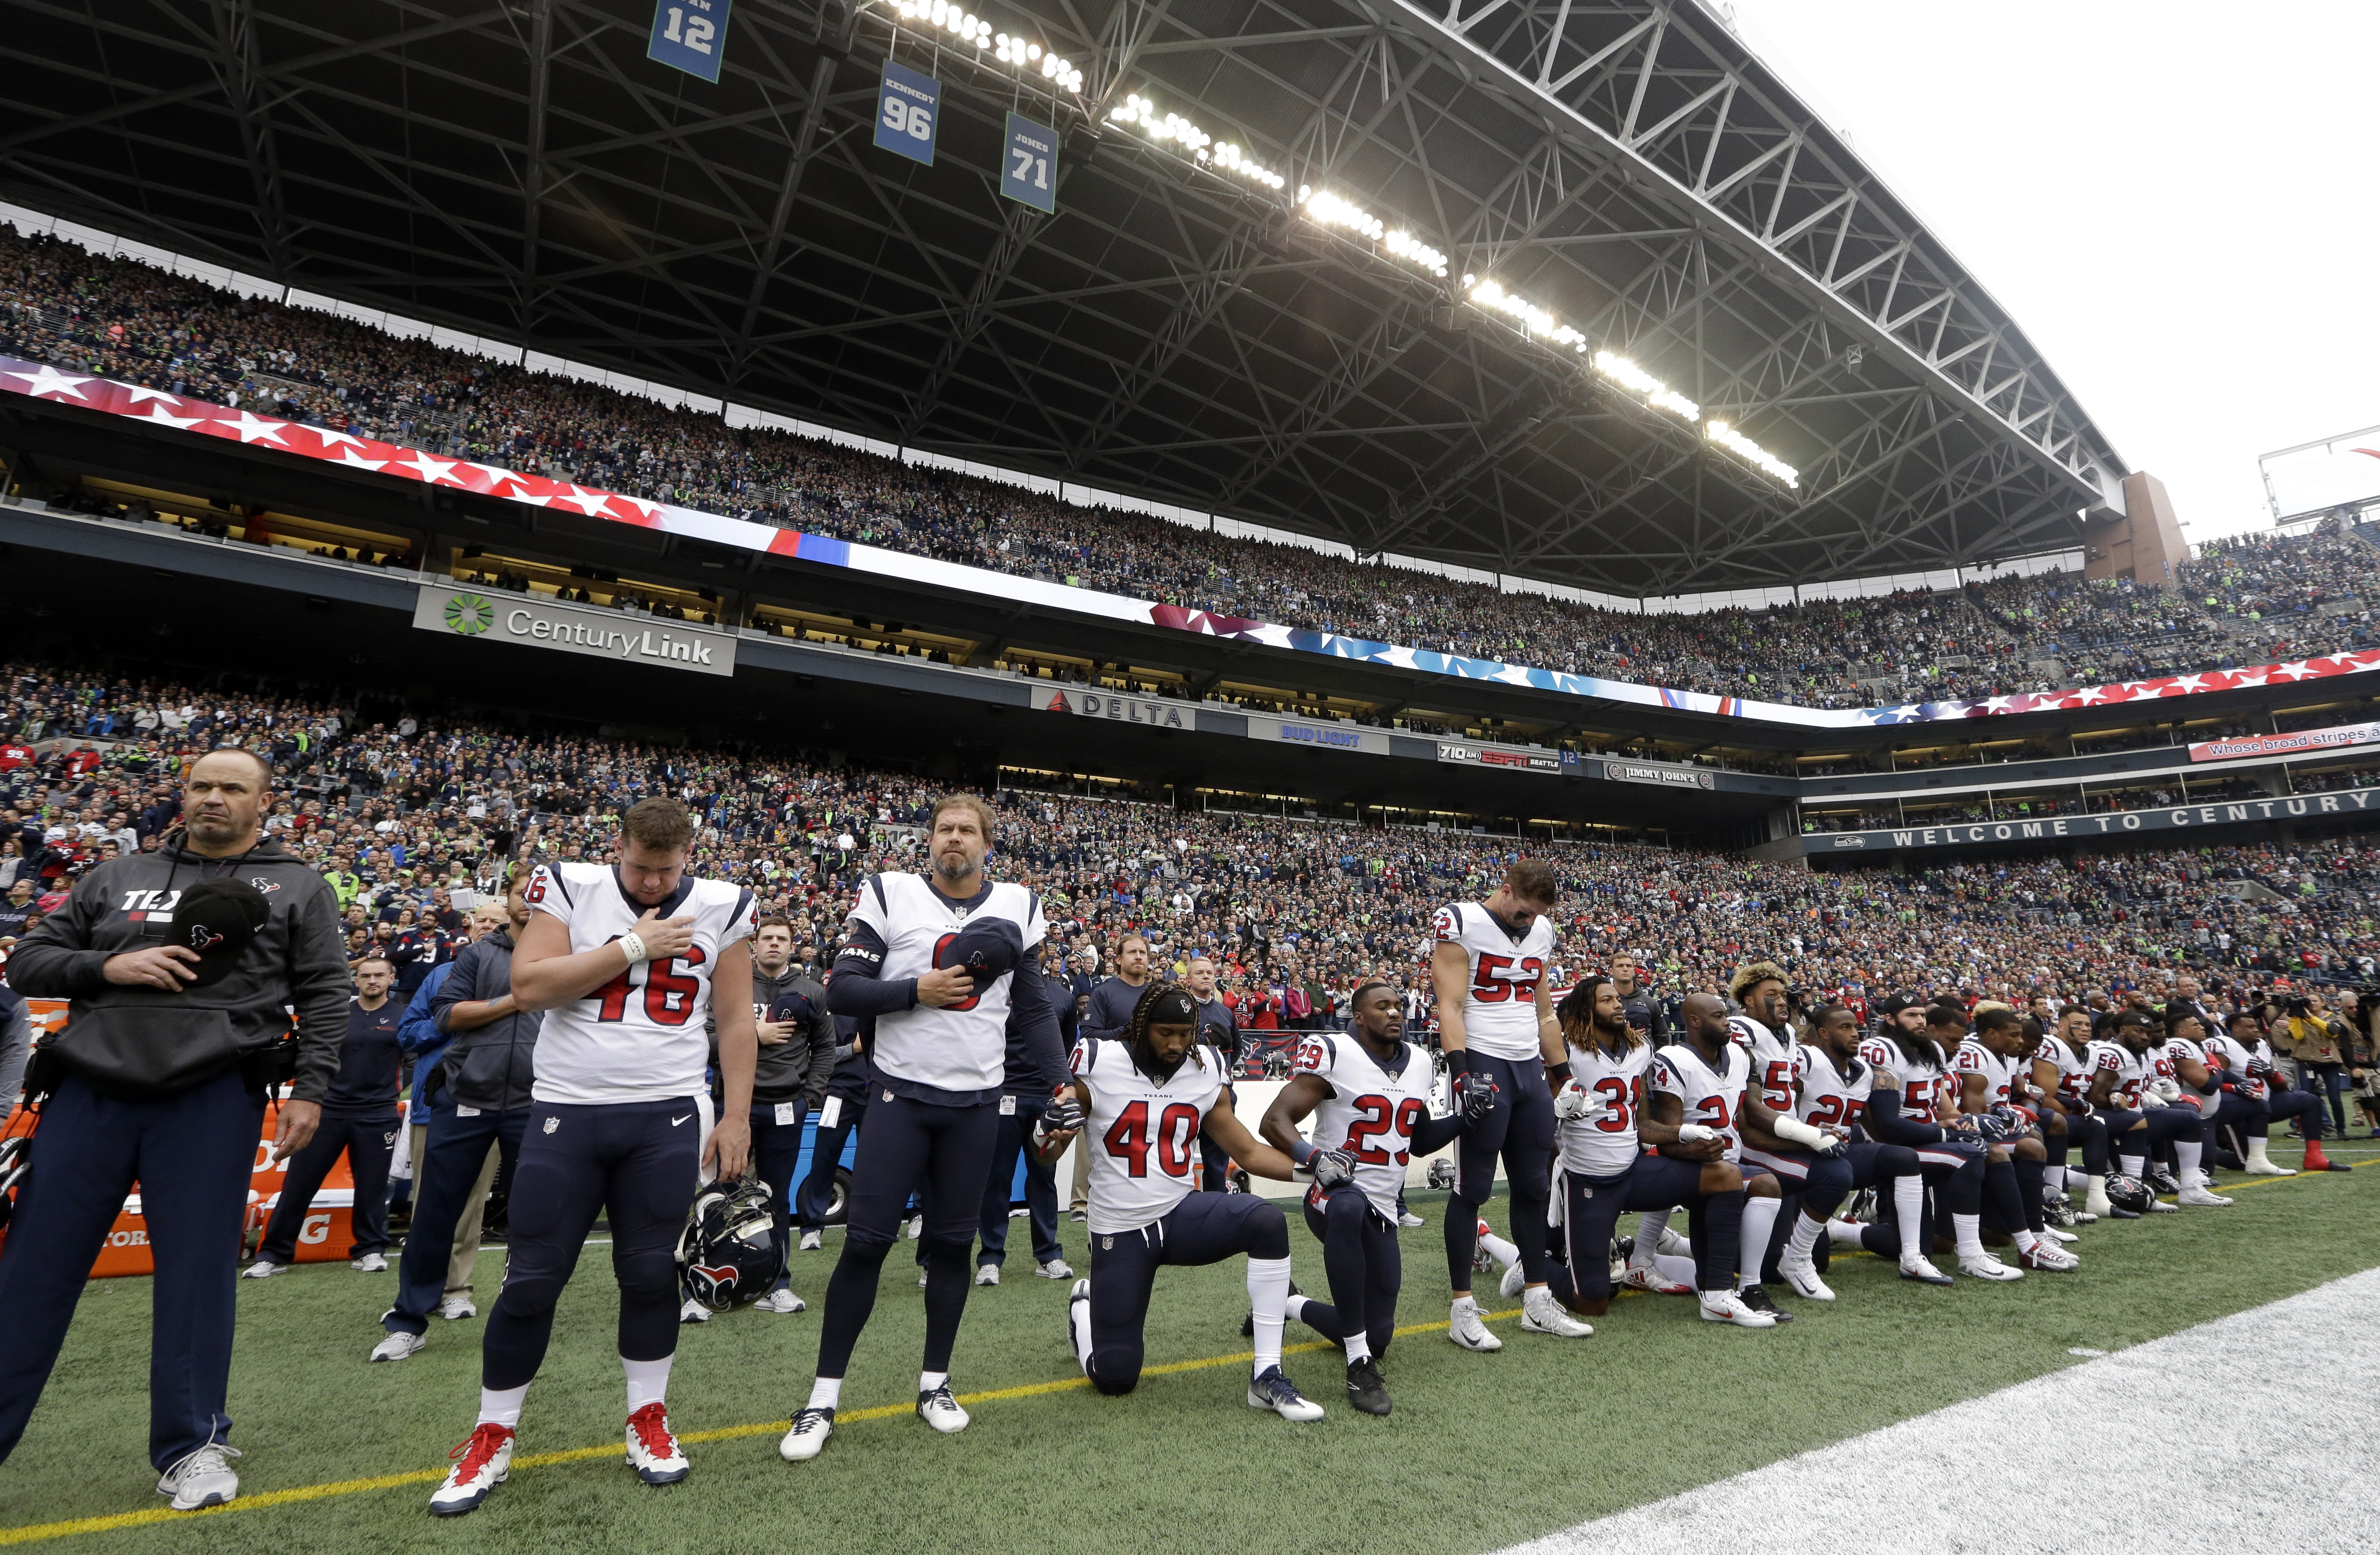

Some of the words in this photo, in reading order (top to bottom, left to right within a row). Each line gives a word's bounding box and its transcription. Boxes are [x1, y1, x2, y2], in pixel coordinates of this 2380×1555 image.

[681, 0, 711, 11] AN
[663, 7, 715, 55] 12
[885, 78, 935, 104] KENNEDY
[882, 95, 932, 141] 96
[1015, 133, 1049, 153] JONES
[1012, 147, 1048, 190] 71
[506, 609, 713, 665] CenturyLink
[1083, 695, 1183, 727] DELTA
[1281, 725, 1314, 742] BUD
[1316, 730, 1360, 748] LIGHT
[2209, 742, 2261, 757] Whose
[2264, 735, 2309, 751] broad
[2313, 729, 2367, 746] stripes
[6, 750, 25, 759] 99
[1440, 746, 1466, 760] 710
[1481, 751, 1528, 767] ESPN
[1530, 759, 1559, 768] SEATTLE
[1563, 752, 1575, 764] 12
[1625, 768, 1659, 778] JIMMY
[1662, 771, 1695, 782] JOHN'S
[17, 786, 31, 797] 3
[1893, 820, 2068, 846] WELCOME
[2095, 814, 2141, 832] TO
[2171, 792, 2369, 826] CENTURY
[1471, 952, 1543, 1003] 52
[1860, 1046, 1885, 1065] 50
[1960, 1052, 1979, 1069] 21
[2099, 1054, 2120, 1070] 58
[2170, 1047, 2186, 1059] 95
[1347, 1094, 1423, 1166] 29
[1806, 1094, 1865, 1141] 25
[1103, 1100, 1200, 1178] 40
[298, 1214, 331, 1244] G
